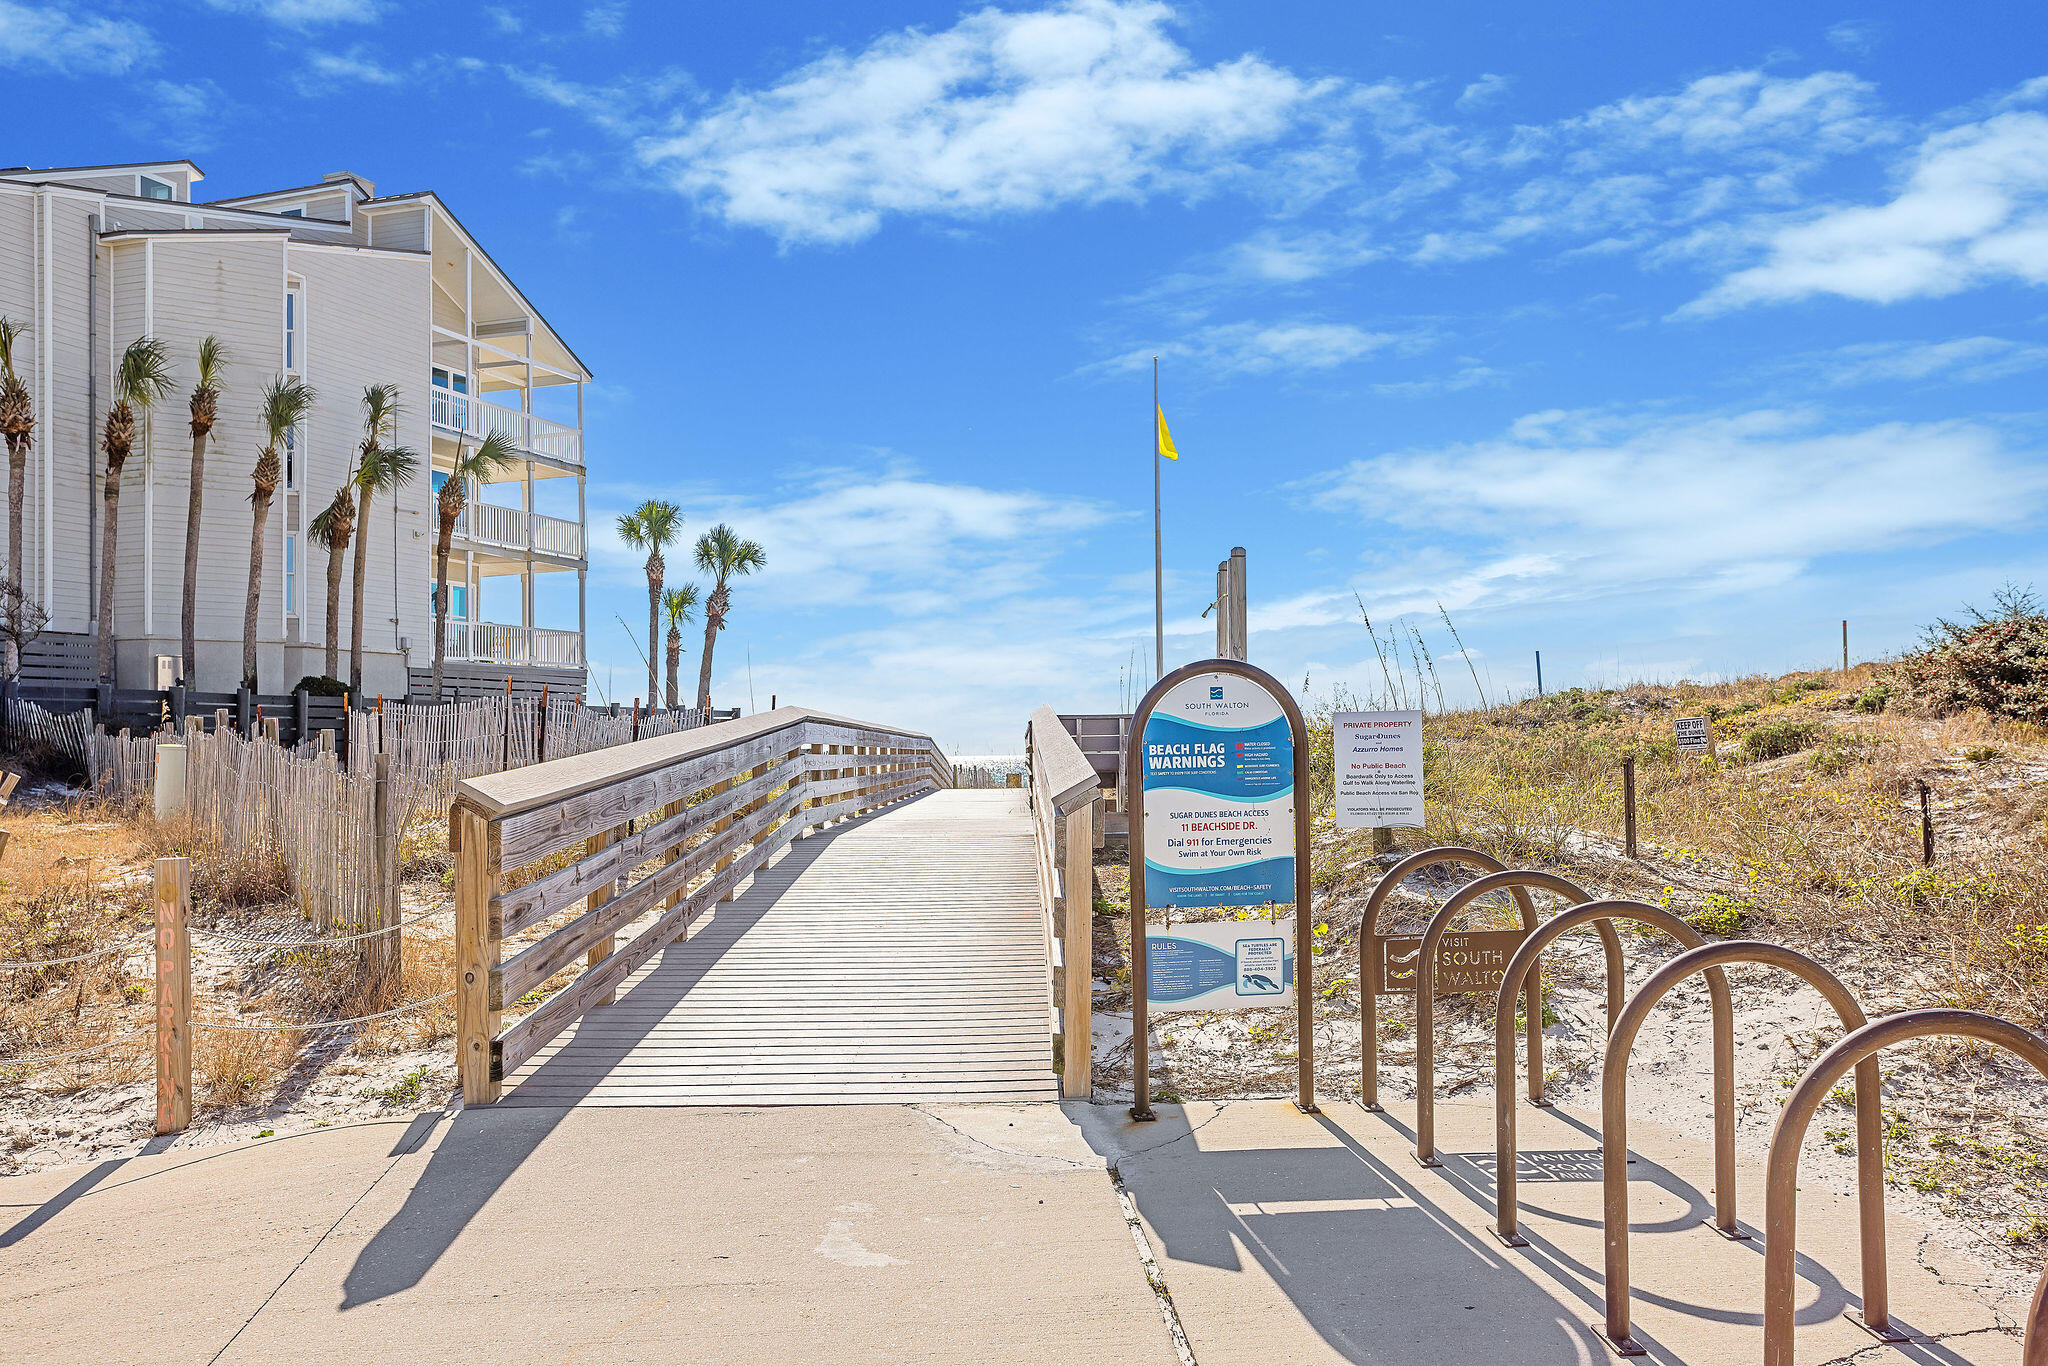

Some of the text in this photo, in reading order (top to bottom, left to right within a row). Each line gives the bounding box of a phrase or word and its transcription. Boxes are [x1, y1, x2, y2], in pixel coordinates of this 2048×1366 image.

[1677, 720, 1703, 730] KEEP OFF
[1149, 743, 1225, 755] BEACH FLAG
[1149, 755, 1226, 769] WARNINGS
[1181, 822, 1258, 832] 11 BEACHSIDE DR.
[1167, 836, 1272, 847] Dial 911 for Emergencies
[1178, 850, 1198, 858] Swim
[1442, 938, 1469, 947] VISIT
[1442, 950, 1503, 966] SOUTH
[1443, 970, 1504, 986] WALTO
[159, 903, 176, 1124] NO PARKING
